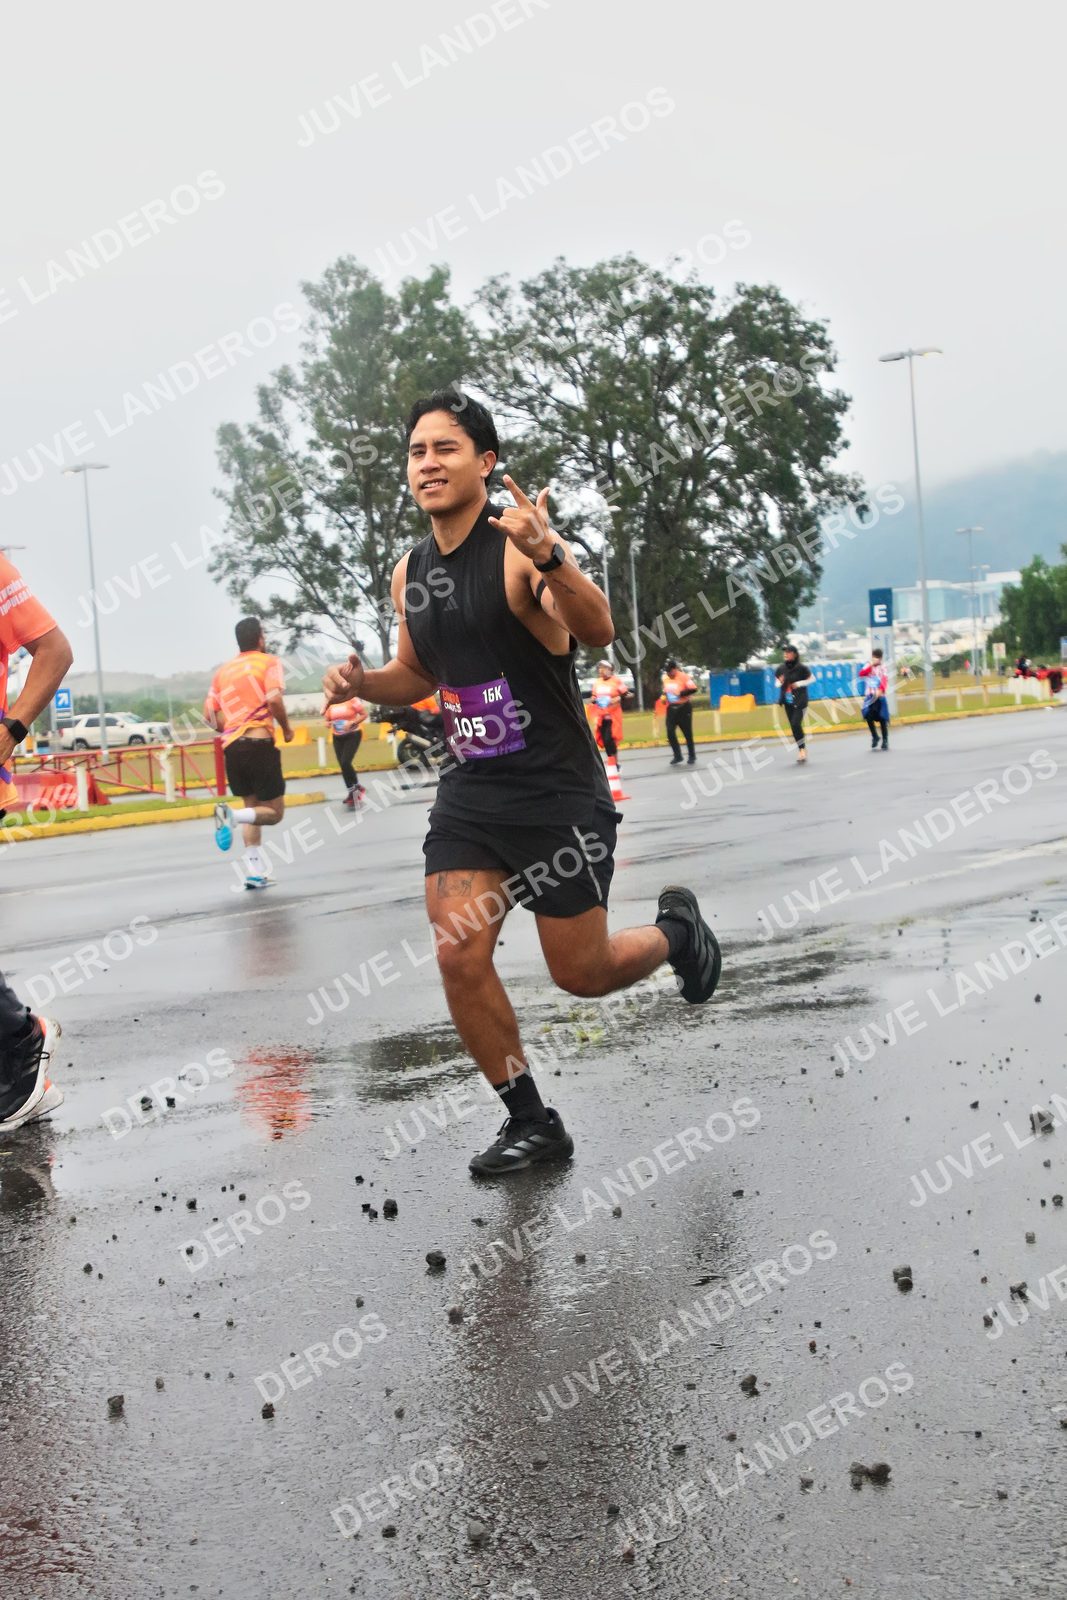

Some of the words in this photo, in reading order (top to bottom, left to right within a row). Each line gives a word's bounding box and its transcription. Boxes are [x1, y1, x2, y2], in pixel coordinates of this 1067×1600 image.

[873, 604, 888, 623] E
[482, 685, 503, 704] 16K
[454, 716, 487, 738] 105
